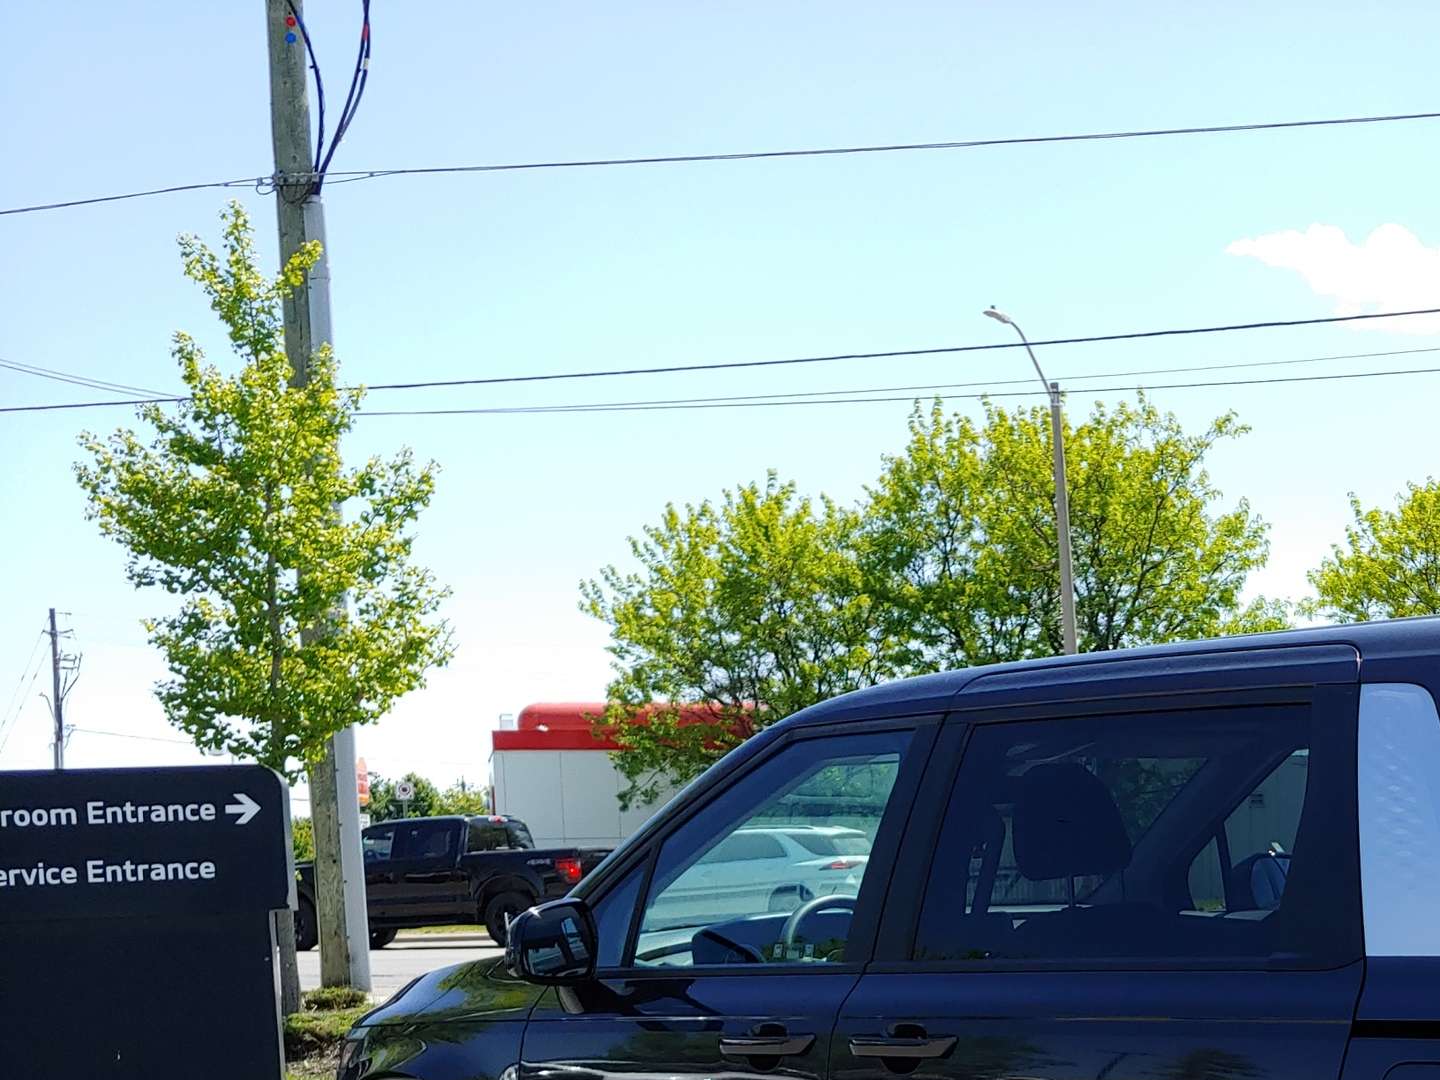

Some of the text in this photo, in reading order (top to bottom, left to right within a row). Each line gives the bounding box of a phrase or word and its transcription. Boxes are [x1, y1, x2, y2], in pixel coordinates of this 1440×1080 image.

[0, 801, 216, 827] room Entrance
[86, 860, 216, 884] Entrance
